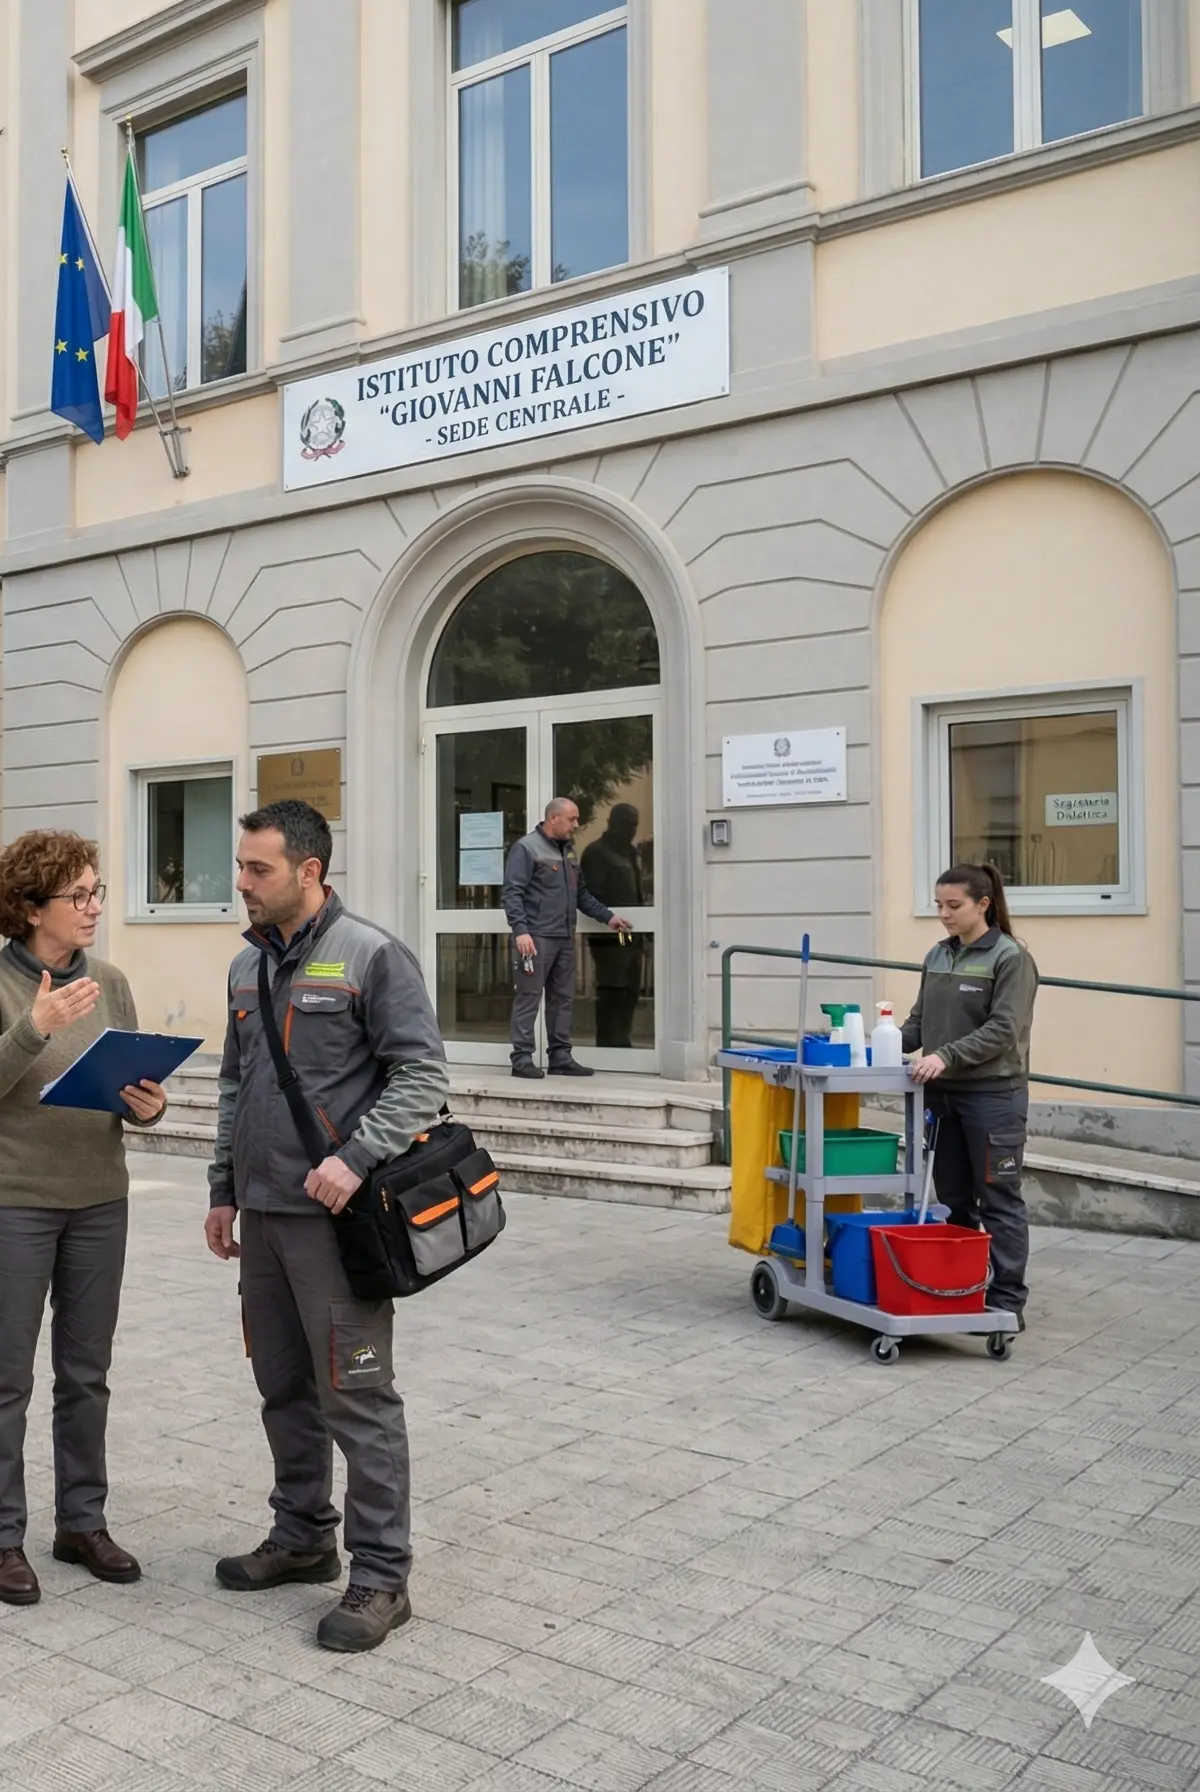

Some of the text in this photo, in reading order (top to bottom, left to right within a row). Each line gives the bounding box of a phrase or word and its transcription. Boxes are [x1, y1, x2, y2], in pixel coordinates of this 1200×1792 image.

[357, 289, 705, 402] ISTITUTO COMPRENSIVO
[380, 331, 680, 427] “GIOVANNI FALCONE”
[437, 416, 489, 446] SEDE
[495, 388, 611, 432] CENTRALE
